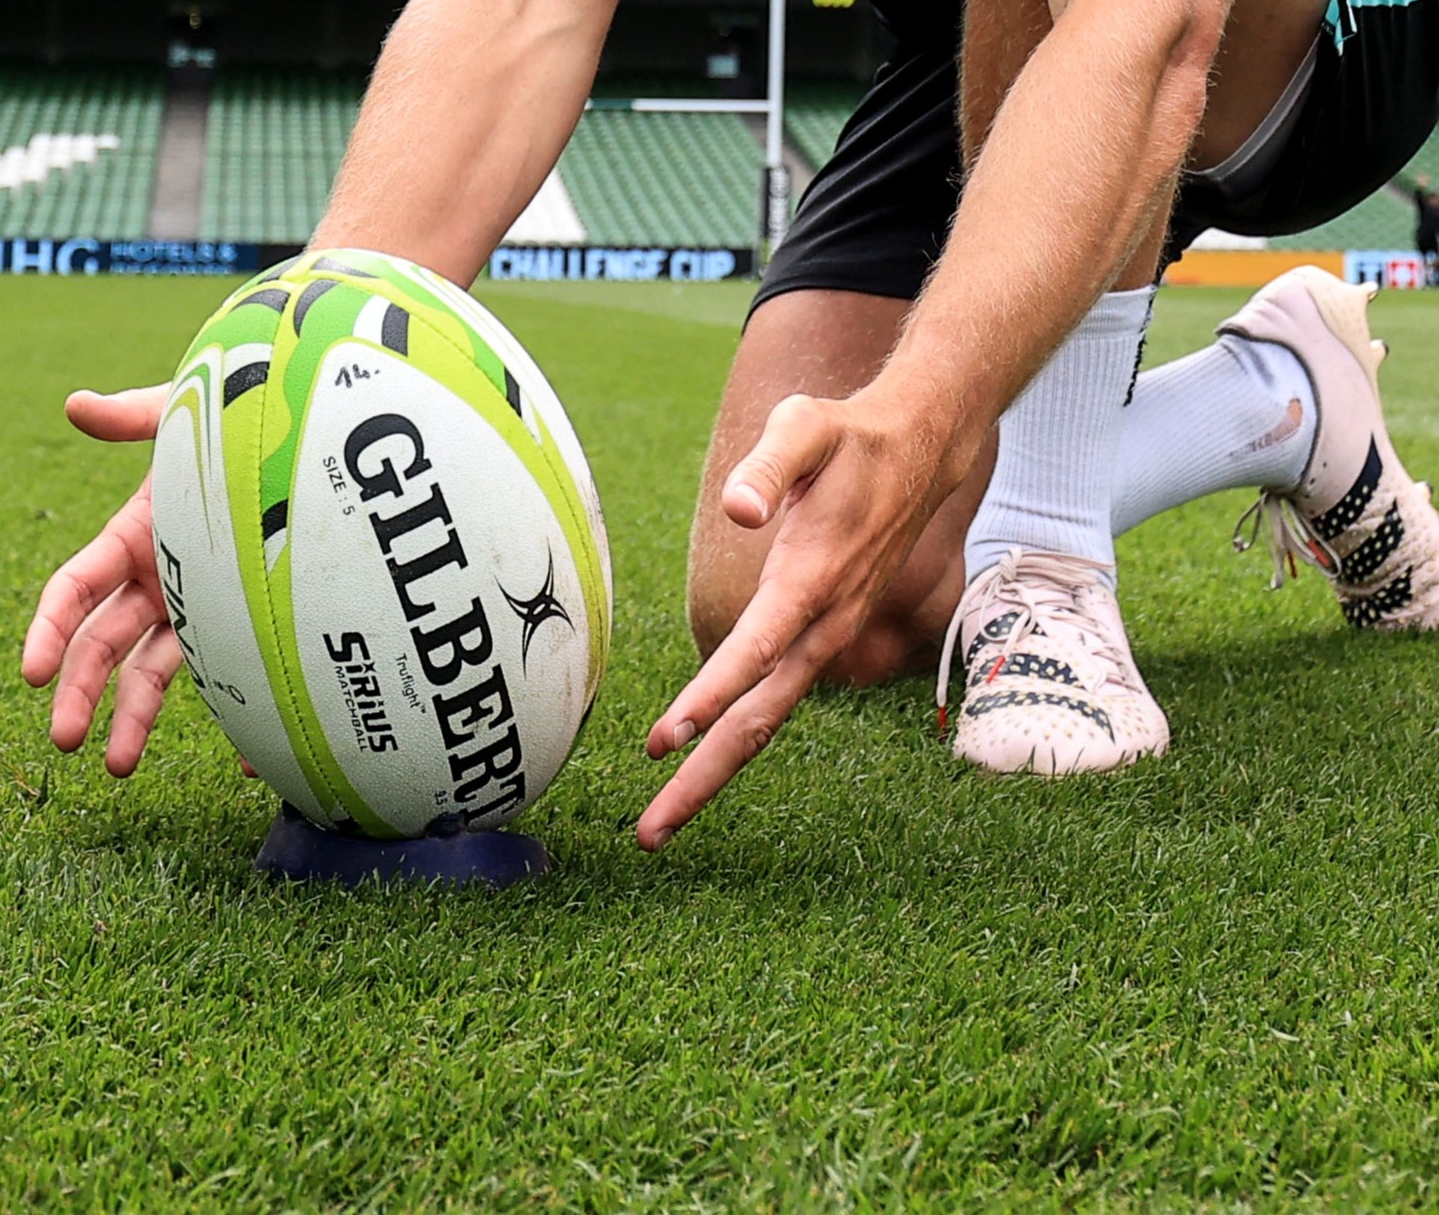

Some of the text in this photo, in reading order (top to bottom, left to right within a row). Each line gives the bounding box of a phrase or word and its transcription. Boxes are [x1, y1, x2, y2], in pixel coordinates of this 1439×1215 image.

[489, 248, 736, 282] CHALLENGE CUP
[322, 455, 348, 494] SIZE
[343, 413, 526, 826] GILBERT
[334, 665, 369, 753] MATCHBALL
